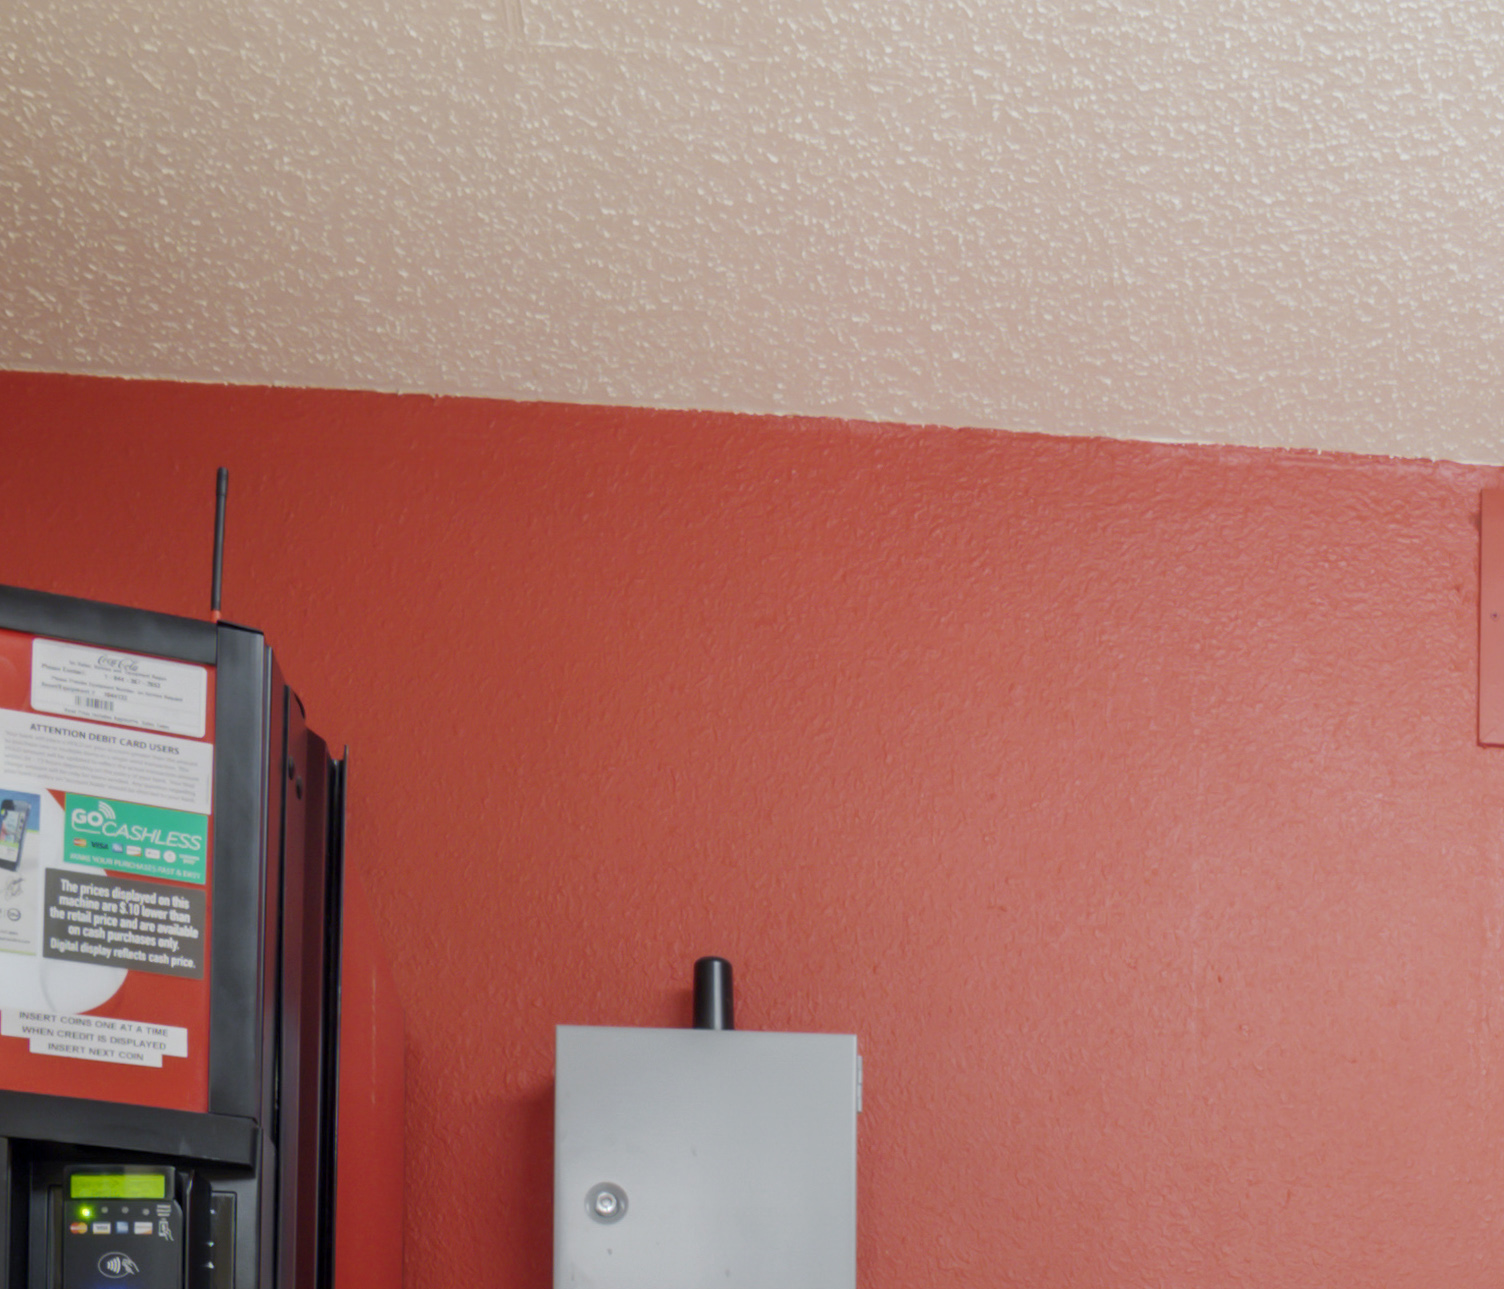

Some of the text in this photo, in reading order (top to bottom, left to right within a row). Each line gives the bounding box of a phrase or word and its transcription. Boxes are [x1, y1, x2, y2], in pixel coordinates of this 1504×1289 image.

[30, 722, 180, 756] ATTENTION DEBIT CARD USERS
[71, 808, 203, 851] GO CASHLESS
[59, 895, 191, 923] machine are $.10 lower than
[60, 878, 190, 910] The prices displayed on this
[50, 906, 199, 939] the retail price and are available
[50, 937, 196, 969] Digital display reflects cash price.
[68, 926, 180, 952] on cash purchases only.
[19, 1011, 169, 1038] INSERT COINS ONE AT A TIME
[22, 1026, 166, 1051] WHEN CREDIT IS DISPLAYED
[48, 1043, 144, 1061] INSERT NEXT COIN
